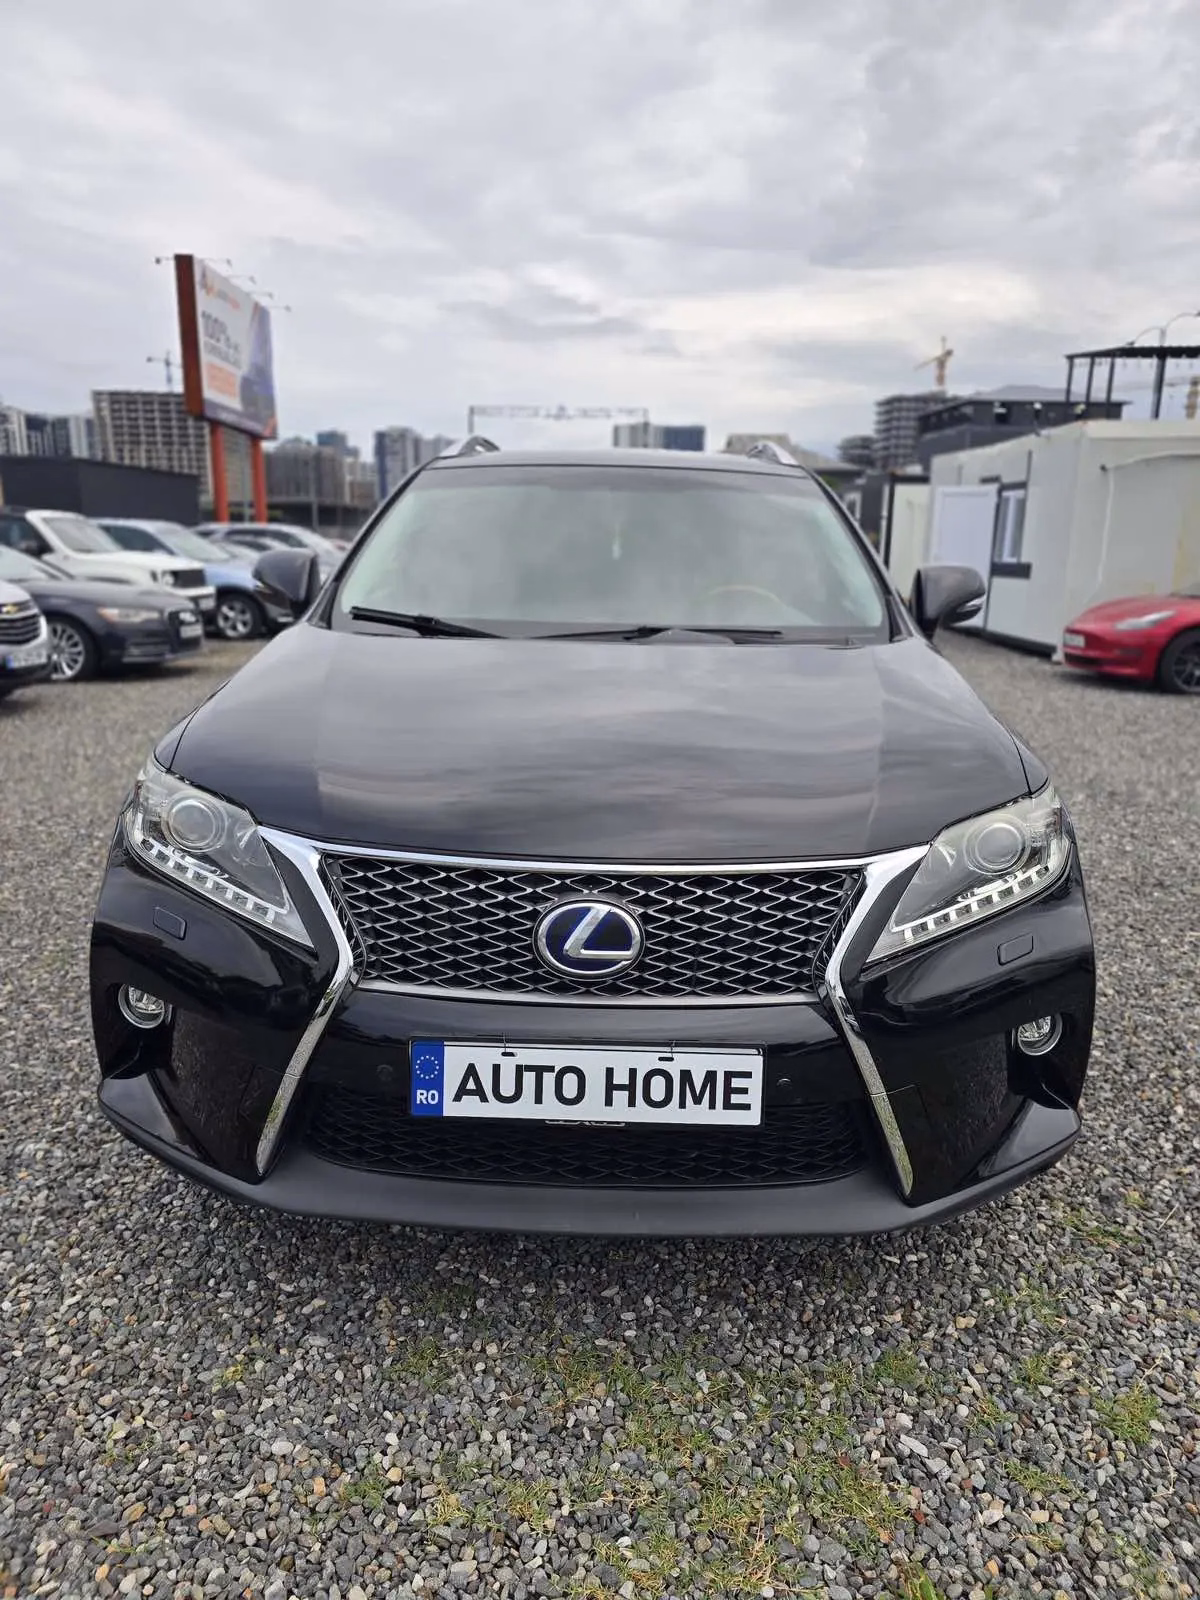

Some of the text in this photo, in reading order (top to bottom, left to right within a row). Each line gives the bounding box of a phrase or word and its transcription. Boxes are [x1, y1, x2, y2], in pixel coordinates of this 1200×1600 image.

[416, 1089, 439, 1105] RO
[452, 1063, 753, 1111] AUTO HOME
